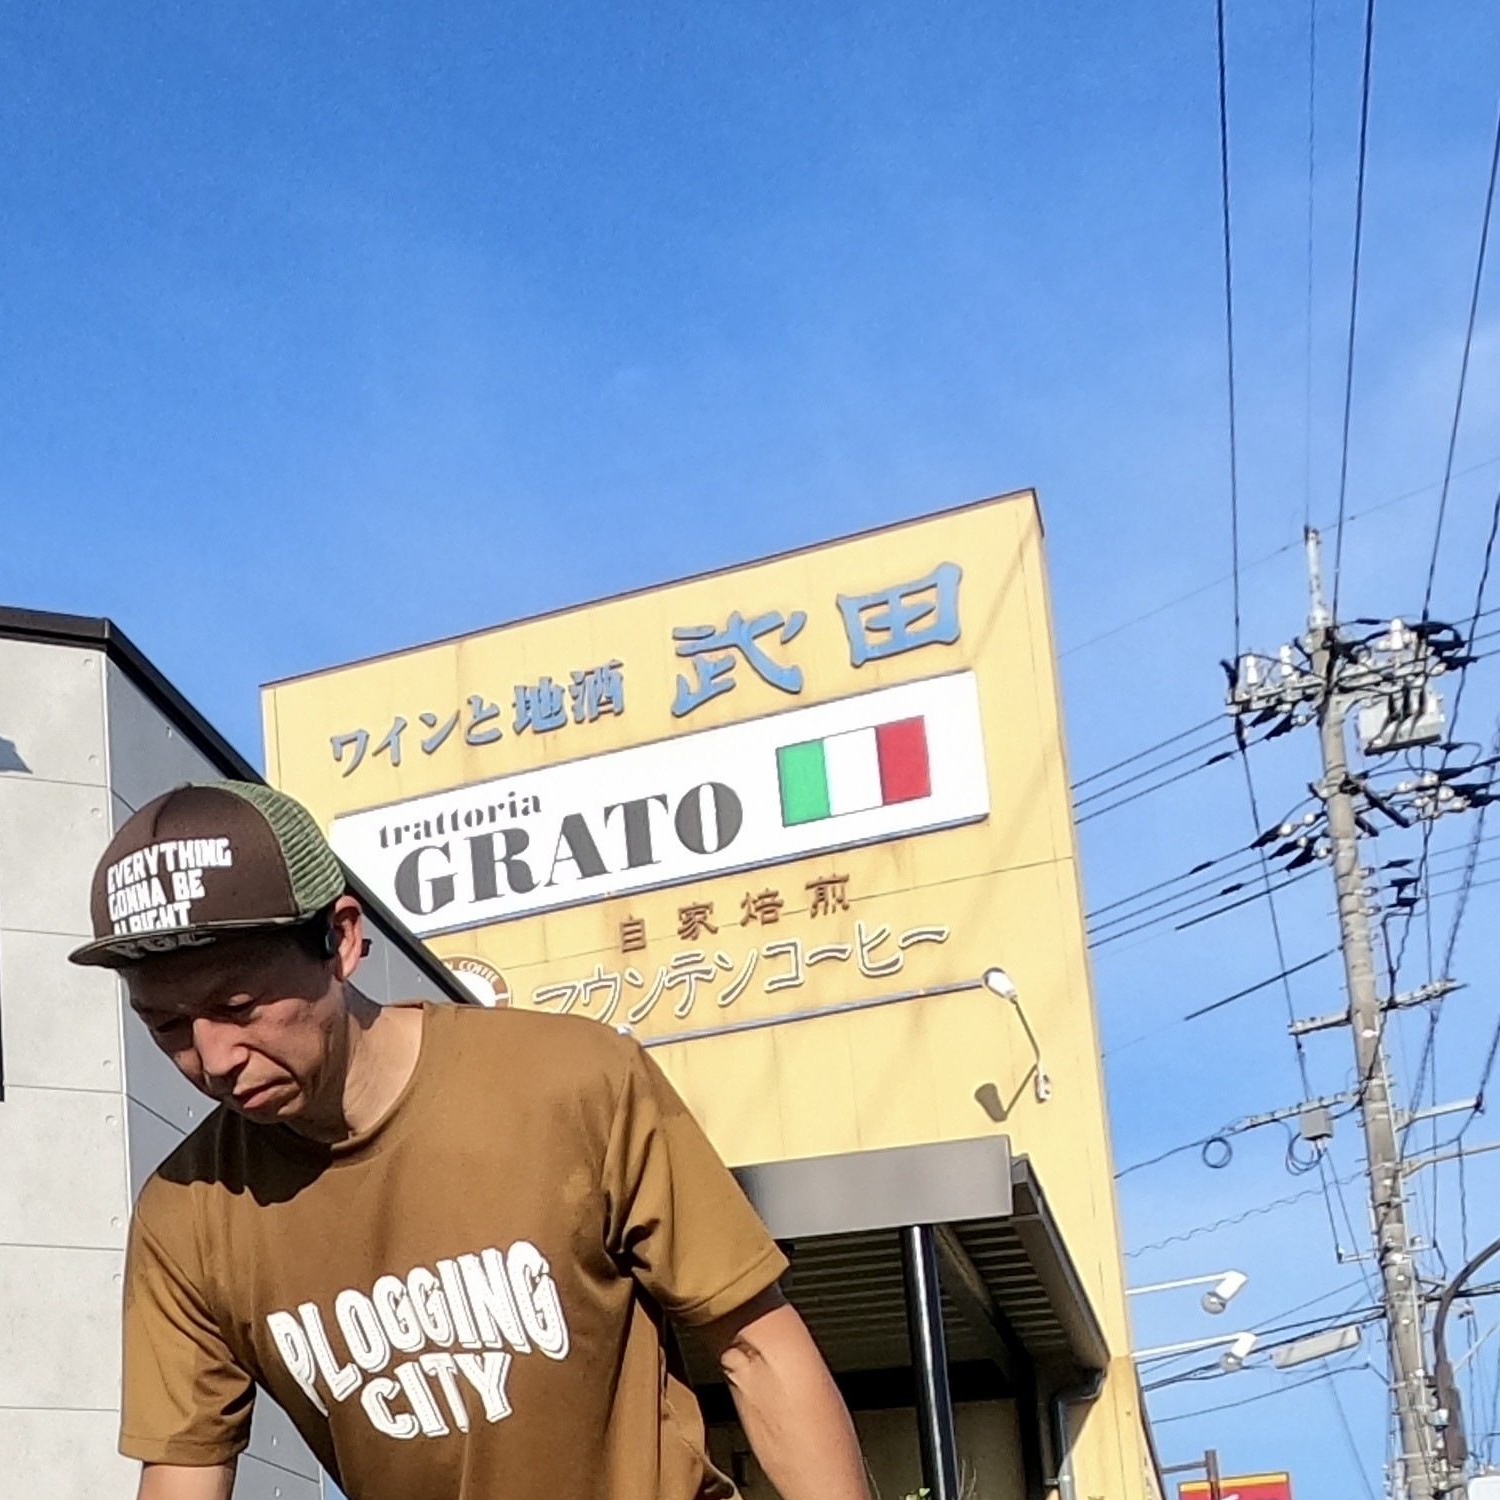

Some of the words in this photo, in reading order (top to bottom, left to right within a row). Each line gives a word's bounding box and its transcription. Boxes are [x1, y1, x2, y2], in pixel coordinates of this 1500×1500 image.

[330, 659, 625, 779] ワインと地酒
[671, 561, 964, 718] 武田
[378, 790, 542, 850] trattoria
[393, 780, 744, 917] GRATO
[106, 838, 233, 895] EVERYTHING
[108, 875, 167, 921] GONNA
[171, 868, 206, 903] BE
[618, 872, 852, 954] 自家焙煎
[531, 920, 951, 1024] マウンテンコーヒー
[265, 1239, 570, 1417] PLOGGING
[360, 1351, 514, 1440] CITY
